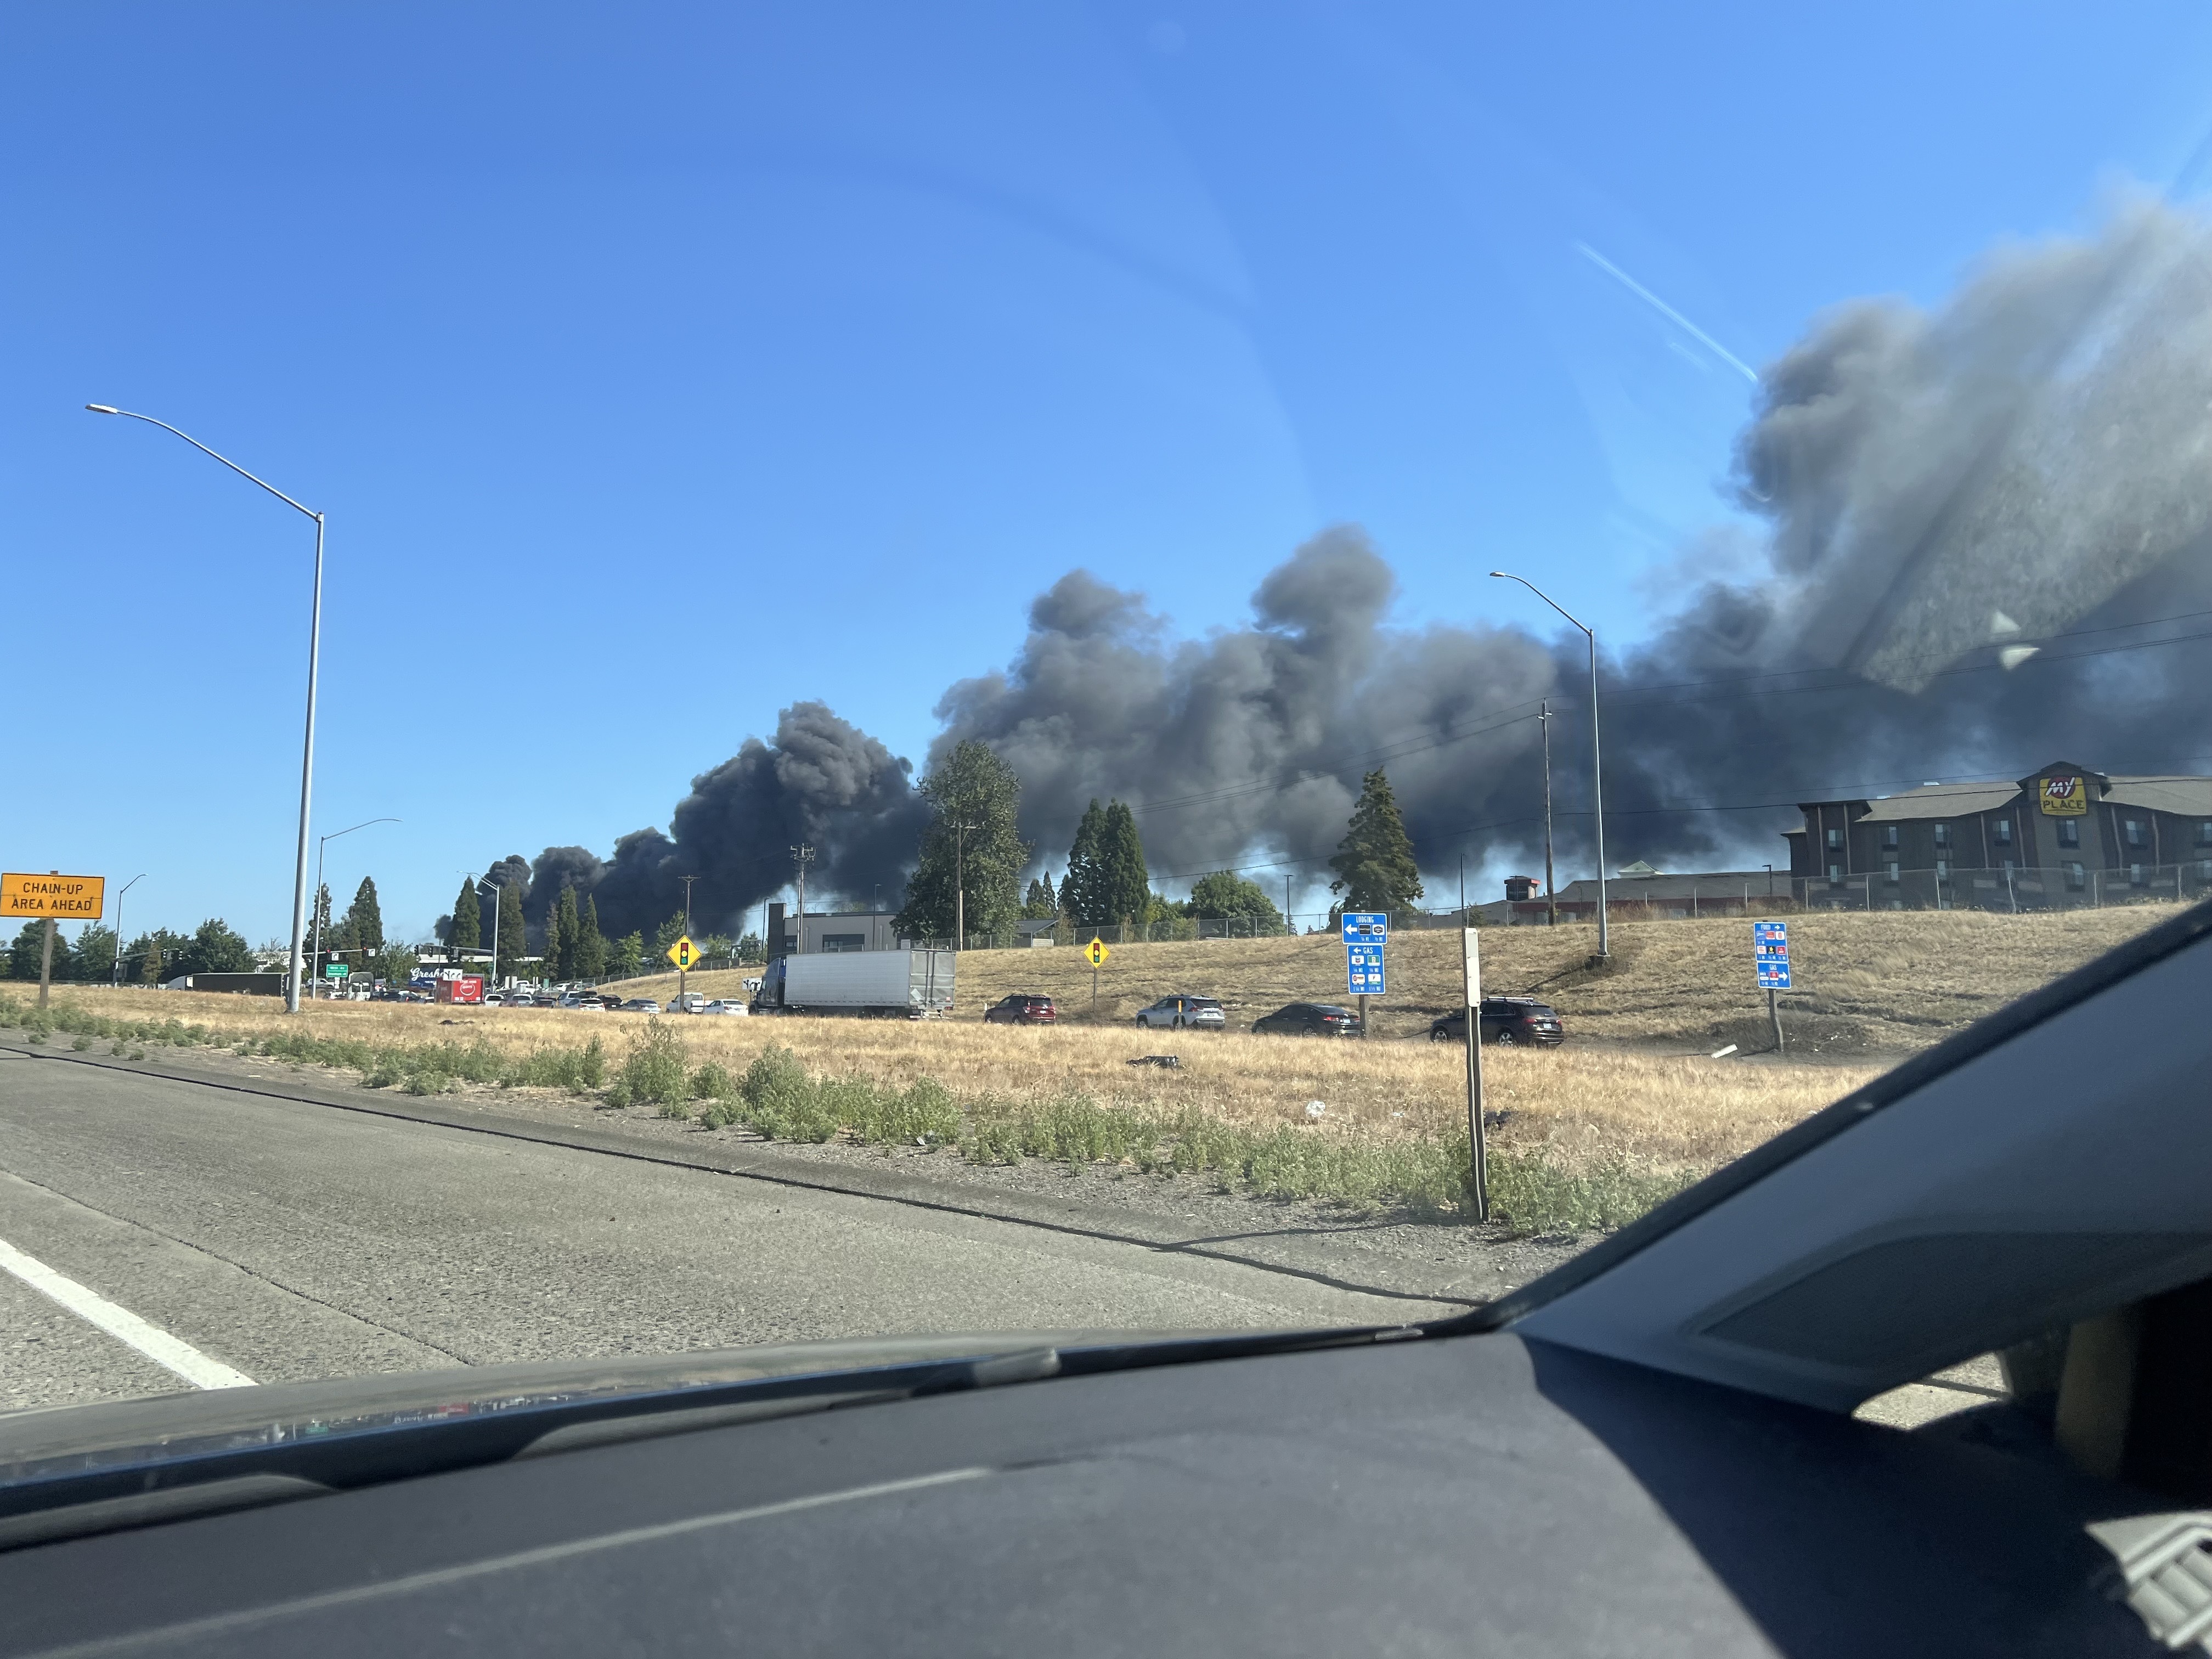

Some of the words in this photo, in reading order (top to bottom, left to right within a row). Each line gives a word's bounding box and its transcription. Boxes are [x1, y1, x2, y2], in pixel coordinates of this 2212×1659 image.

[2043, 800, 2084, 809] PLACE
[23, 882, 83, 895] CHAIN-UP
[11, 898, 43, 910] AREA
[50, 900, 92, 911] AHEAD
